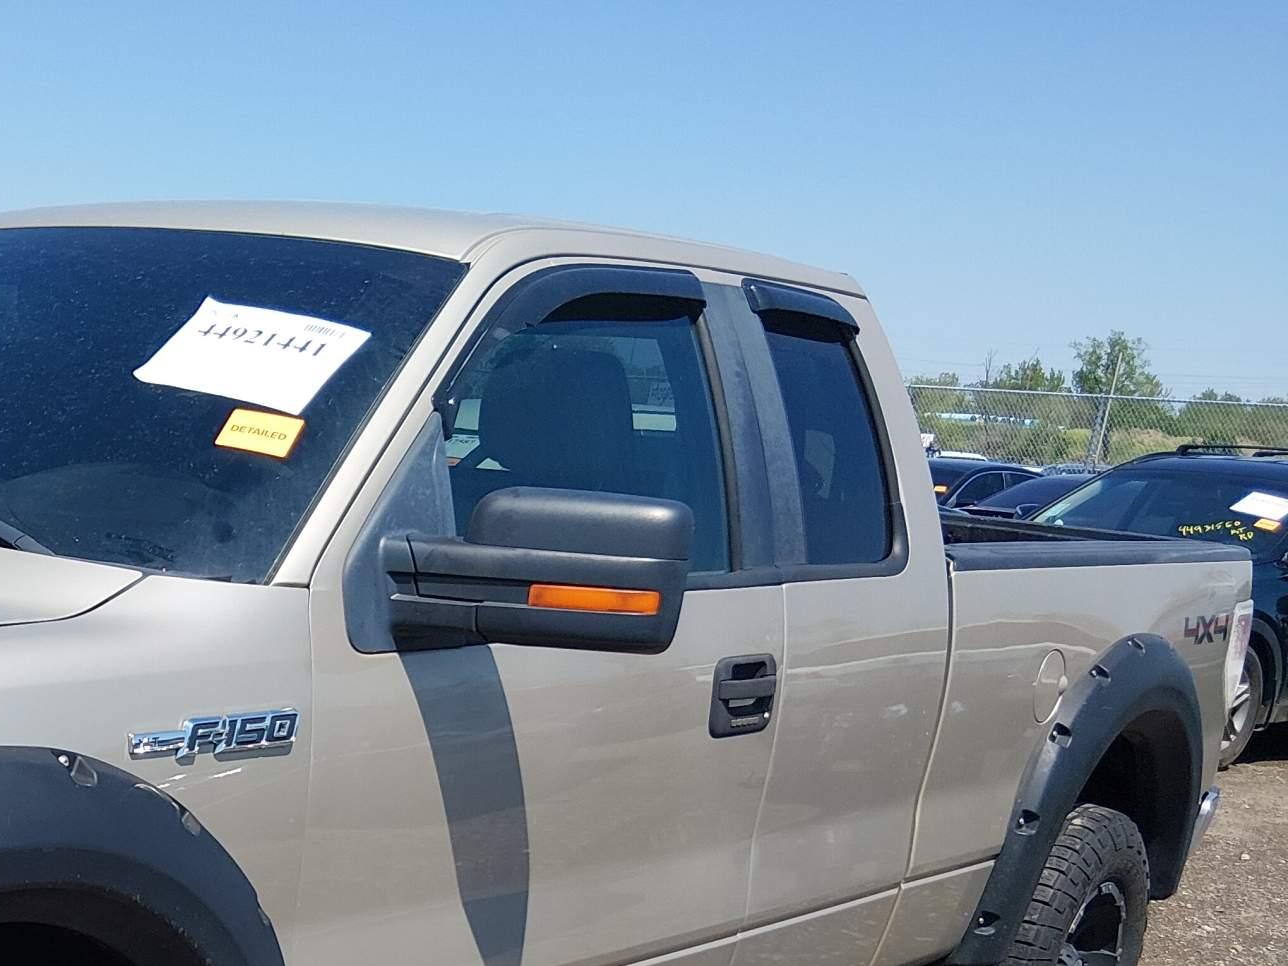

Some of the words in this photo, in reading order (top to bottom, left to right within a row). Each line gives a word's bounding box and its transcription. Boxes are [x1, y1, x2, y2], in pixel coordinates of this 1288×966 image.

[198, 324, 326, 357] 44921441
[230, 423, 287, 442] DETAILED
[1184, 614, 1229, 645] 4X4
